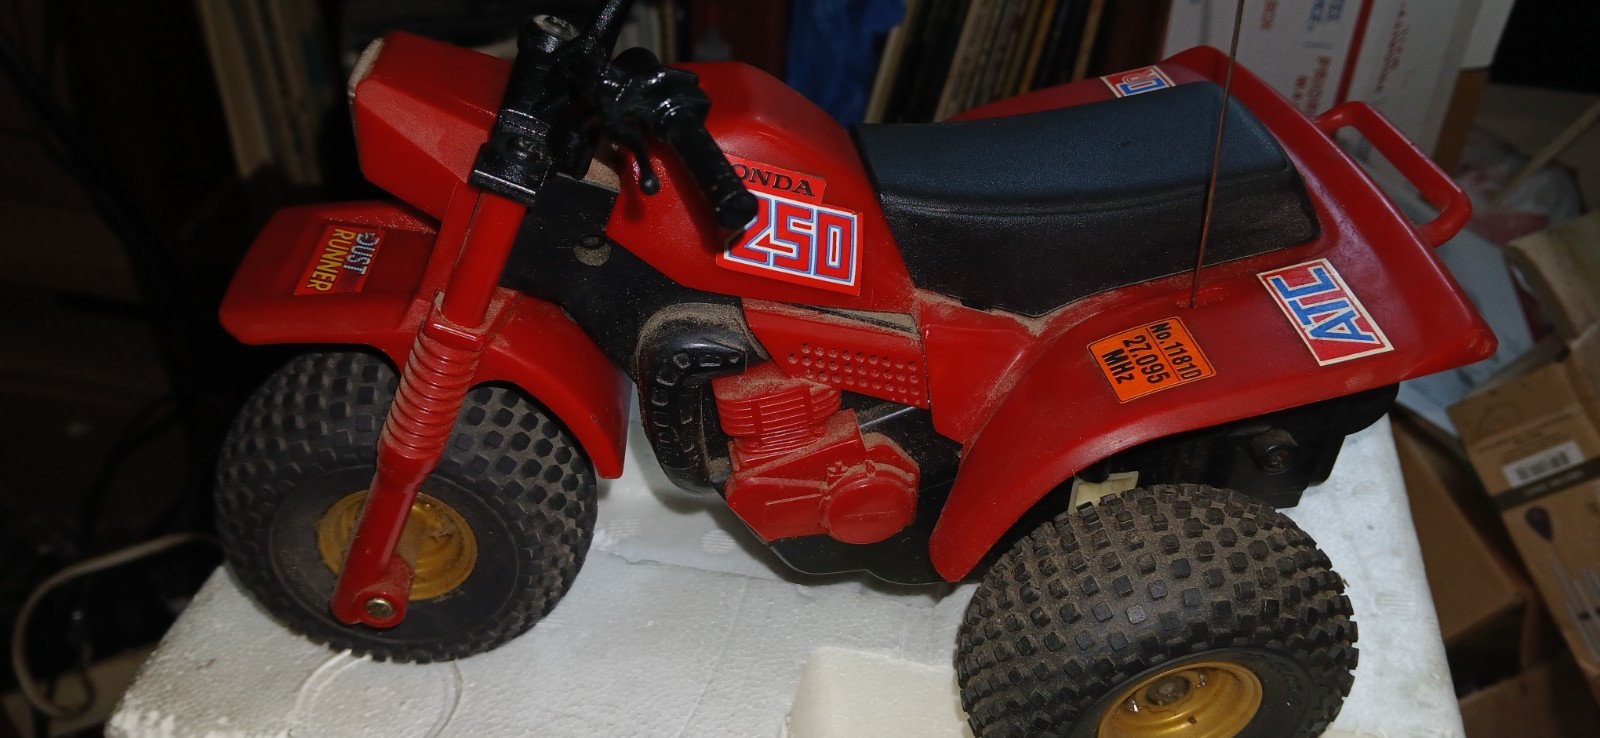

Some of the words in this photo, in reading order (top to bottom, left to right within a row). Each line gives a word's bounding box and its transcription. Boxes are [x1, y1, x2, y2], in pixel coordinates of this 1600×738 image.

[731, 163, 816, 198] ONDA
[306, 228, 356, 291] RUNNER
[343, 231, 380, 275] DUST
[725, 193, 857, 285] 250
[1267, 265, 1379, 343] ATC
[1101, 348, 1135, 385] MHz
[1122, 334, 1171, 384] 27.095
